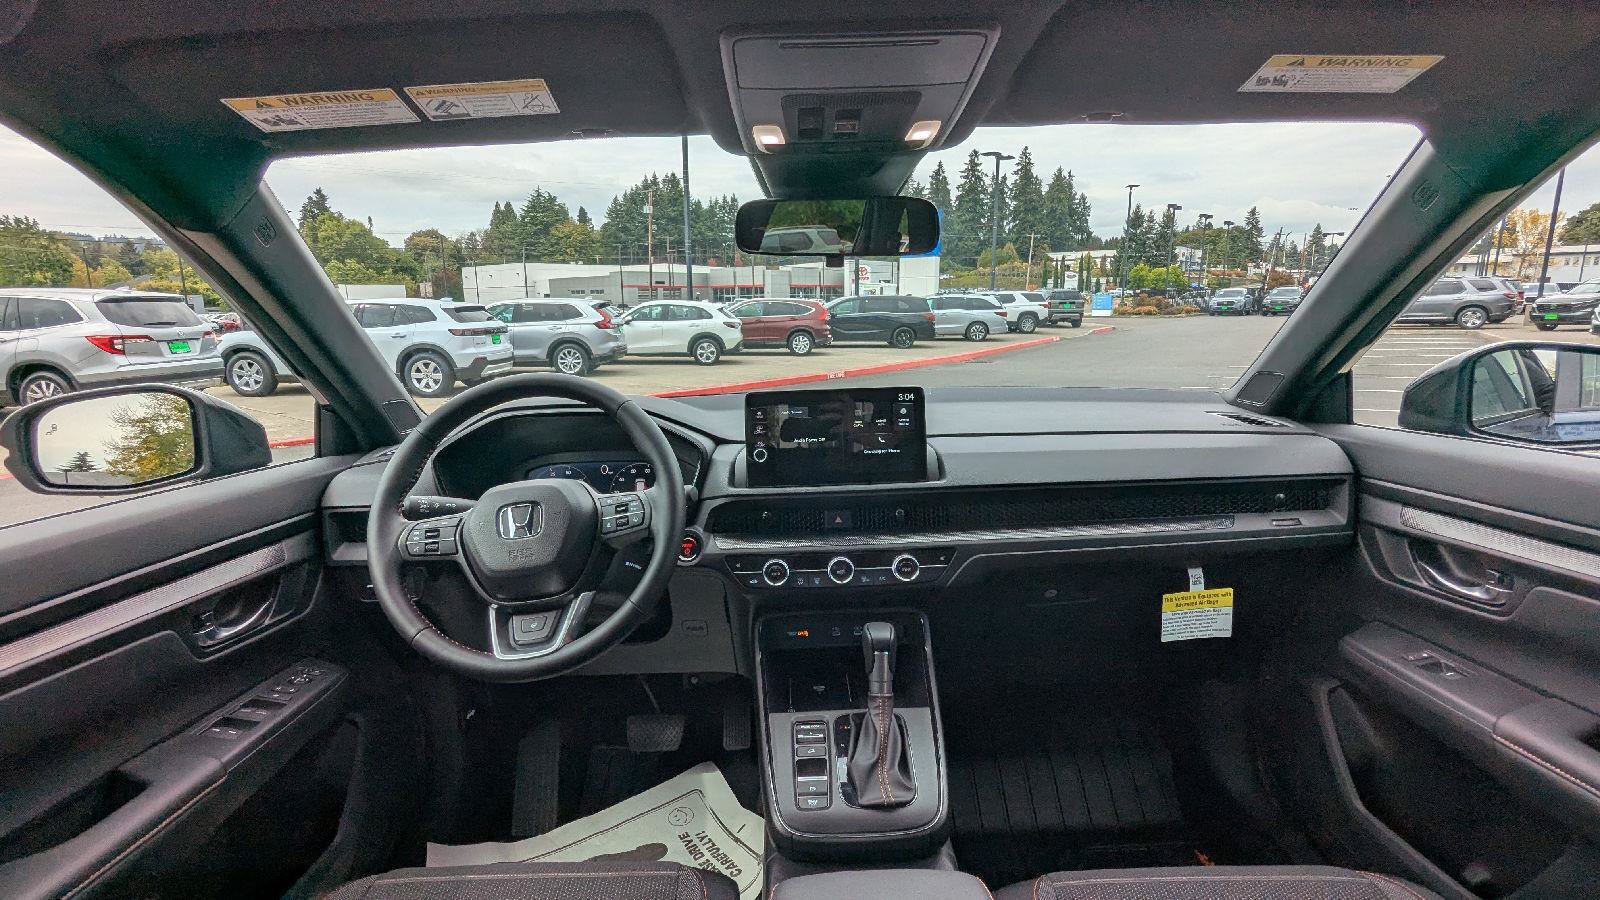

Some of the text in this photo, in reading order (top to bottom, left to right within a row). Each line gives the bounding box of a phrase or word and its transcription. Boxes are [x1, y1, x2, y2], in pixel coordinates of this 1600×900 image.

[1318, 58, 1412, 67] WARNING
[278, 93, 375, 107] WARNING
[898, 393, 914, 401] 3:04
[678, 831, 706, 861] DRIVE
[695, 830, 743, 878] CAREFULLY!
